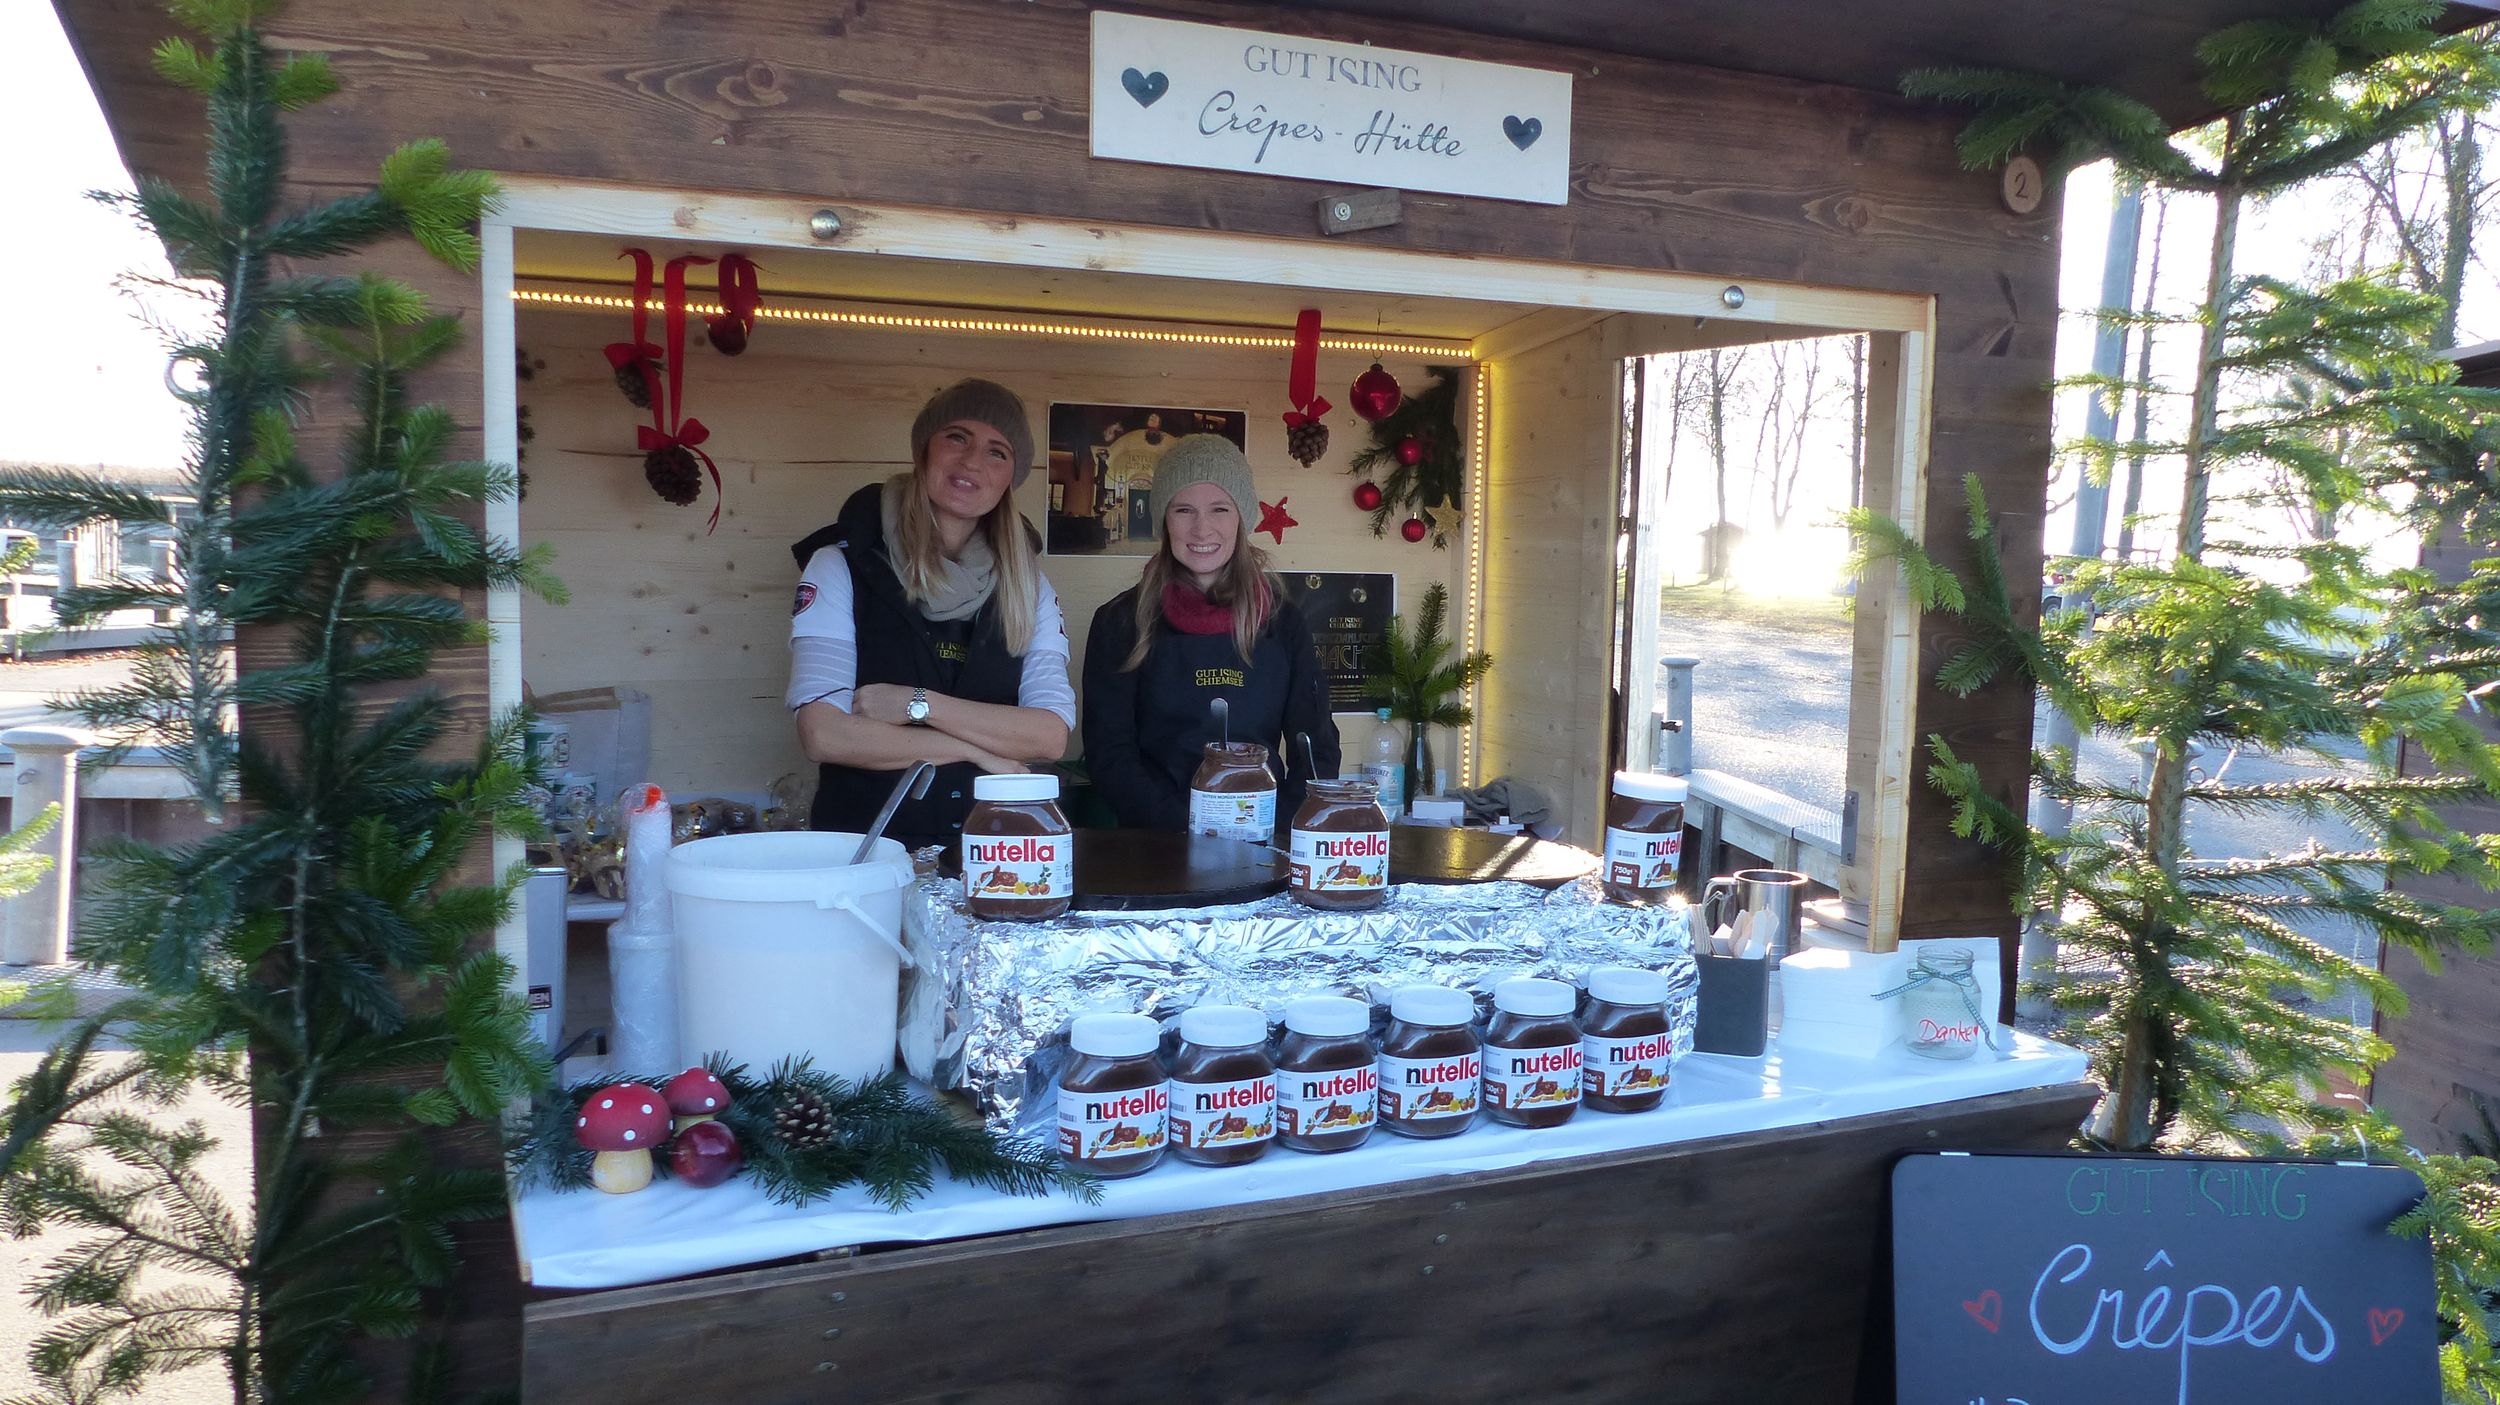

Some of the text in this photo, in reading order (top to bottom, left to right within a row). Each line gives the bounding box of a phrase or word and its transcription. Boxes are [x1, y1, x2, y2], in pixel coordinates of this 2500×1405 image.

[1243, 44, 1422, 93] GUT ISING
[1198, 90, 1324, 164] Crêpes
[1354, 109, 1467, 157] Hütte
[2014, 171, 2029, 200] 2
[1195, 668, 1244, 679] GUT ISING
[1195, 676, 1245, 687] CHIEMSEE
[970, 838, 1055, 862] nutella
[1315, 834, 1388, 857] nutella
[1919, 1019, 1972, 1042] Danke
[1406, 1057, 1480, 1084] nutella
[1511, 1047, 1583, 1074] nutella
[1195, 1080, 1275, 1110] nutella
[1302, 1068, 1377, 1098] nutella
[1086, 1088, 1168, 1120] nutella
[2066, 1166, 2307, 1220] GUT ISING
[2029, 1244, 2336, 1405] Crêpes
